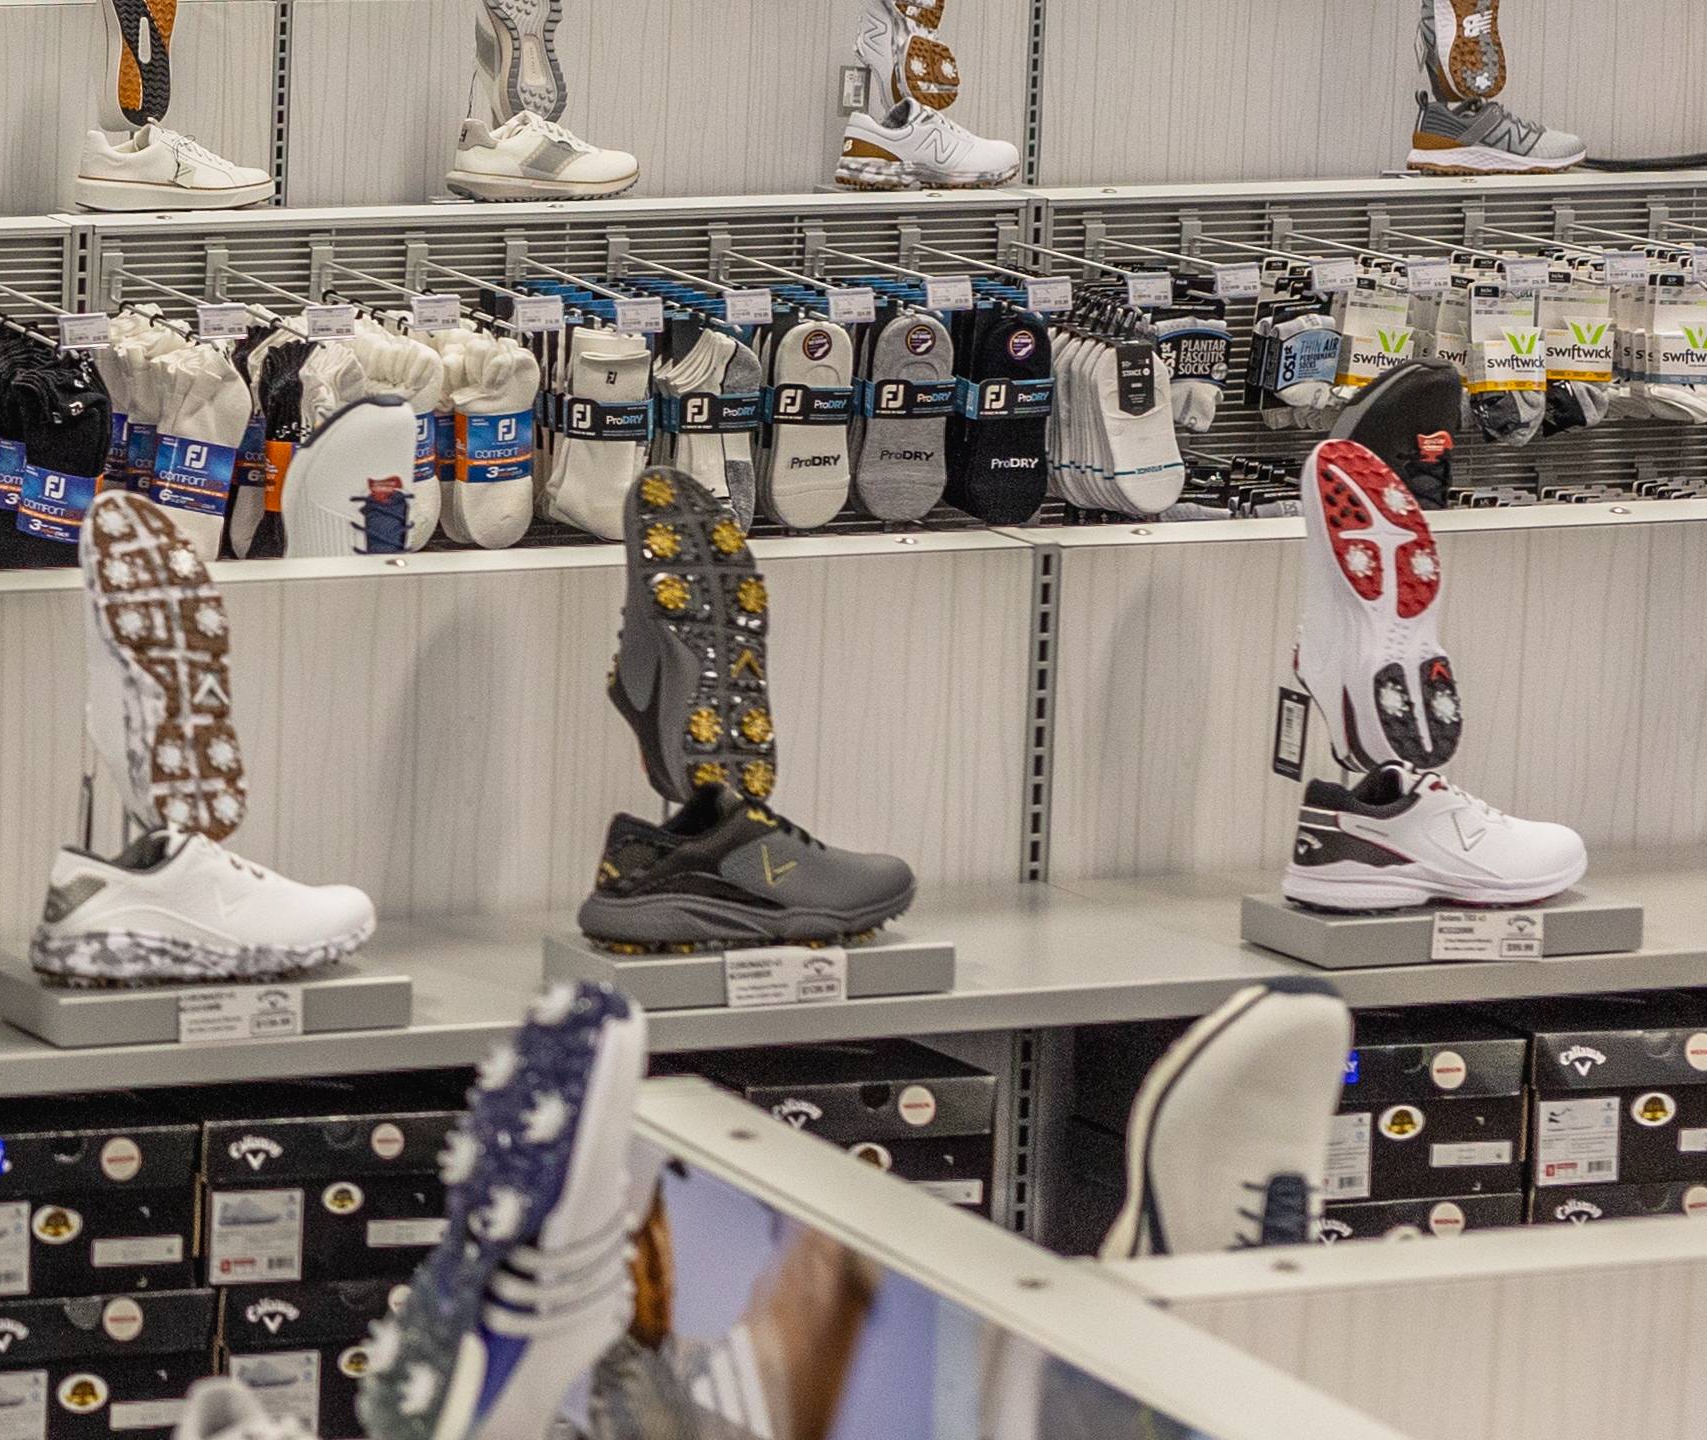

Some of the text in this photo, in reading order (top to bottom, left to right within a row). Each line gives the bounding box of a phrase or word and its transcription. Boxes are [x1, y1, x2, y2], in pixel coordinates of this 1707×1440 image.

[1181, 339, 1226, 352] PLANTAR
[1300, 337, 1340, 353] THIN AIR
[1546, 343, 1612, 359] swiftwick
[1487, 354, 1545, 369] swiftwick
[1662, 348, 1707, 364] swiftw
[1178, 362, 1211, 376] SOCKS
[778, 389, 803, 413] FJ
[880, 384, 904, 408] FJ
[916, 391, 952, 403] ProDRY
[985, 384, 1006, 409] FJ
[1017, 391, 1050, 403] ProDRY
[686, 398, 708, 423] FJ
[722, 404, 756, 417] ProDRY
[813, 399, 847, 410] ProDRY
[572, 403, 591, 428] FJ
[606, 413, 643, 426] ProDRY
[498, 418, 516, 441] FJ
[183, 444, 207, 469] FJ
[790, 454, 841, 469] ProDRY
[881, 449, 935, 462] ProDRY
[990, 457, 1039, 470] ProDRY
[486, 466, 499, 478] 3
[45, 475, 66, 499] FJ
[158, 489, 172, 502] 6
[29, 518, 42, 531] 3
[1559, 1045, 1607, 1066] Callaway
[1556, 1198, 1603, 1220] Callaway
